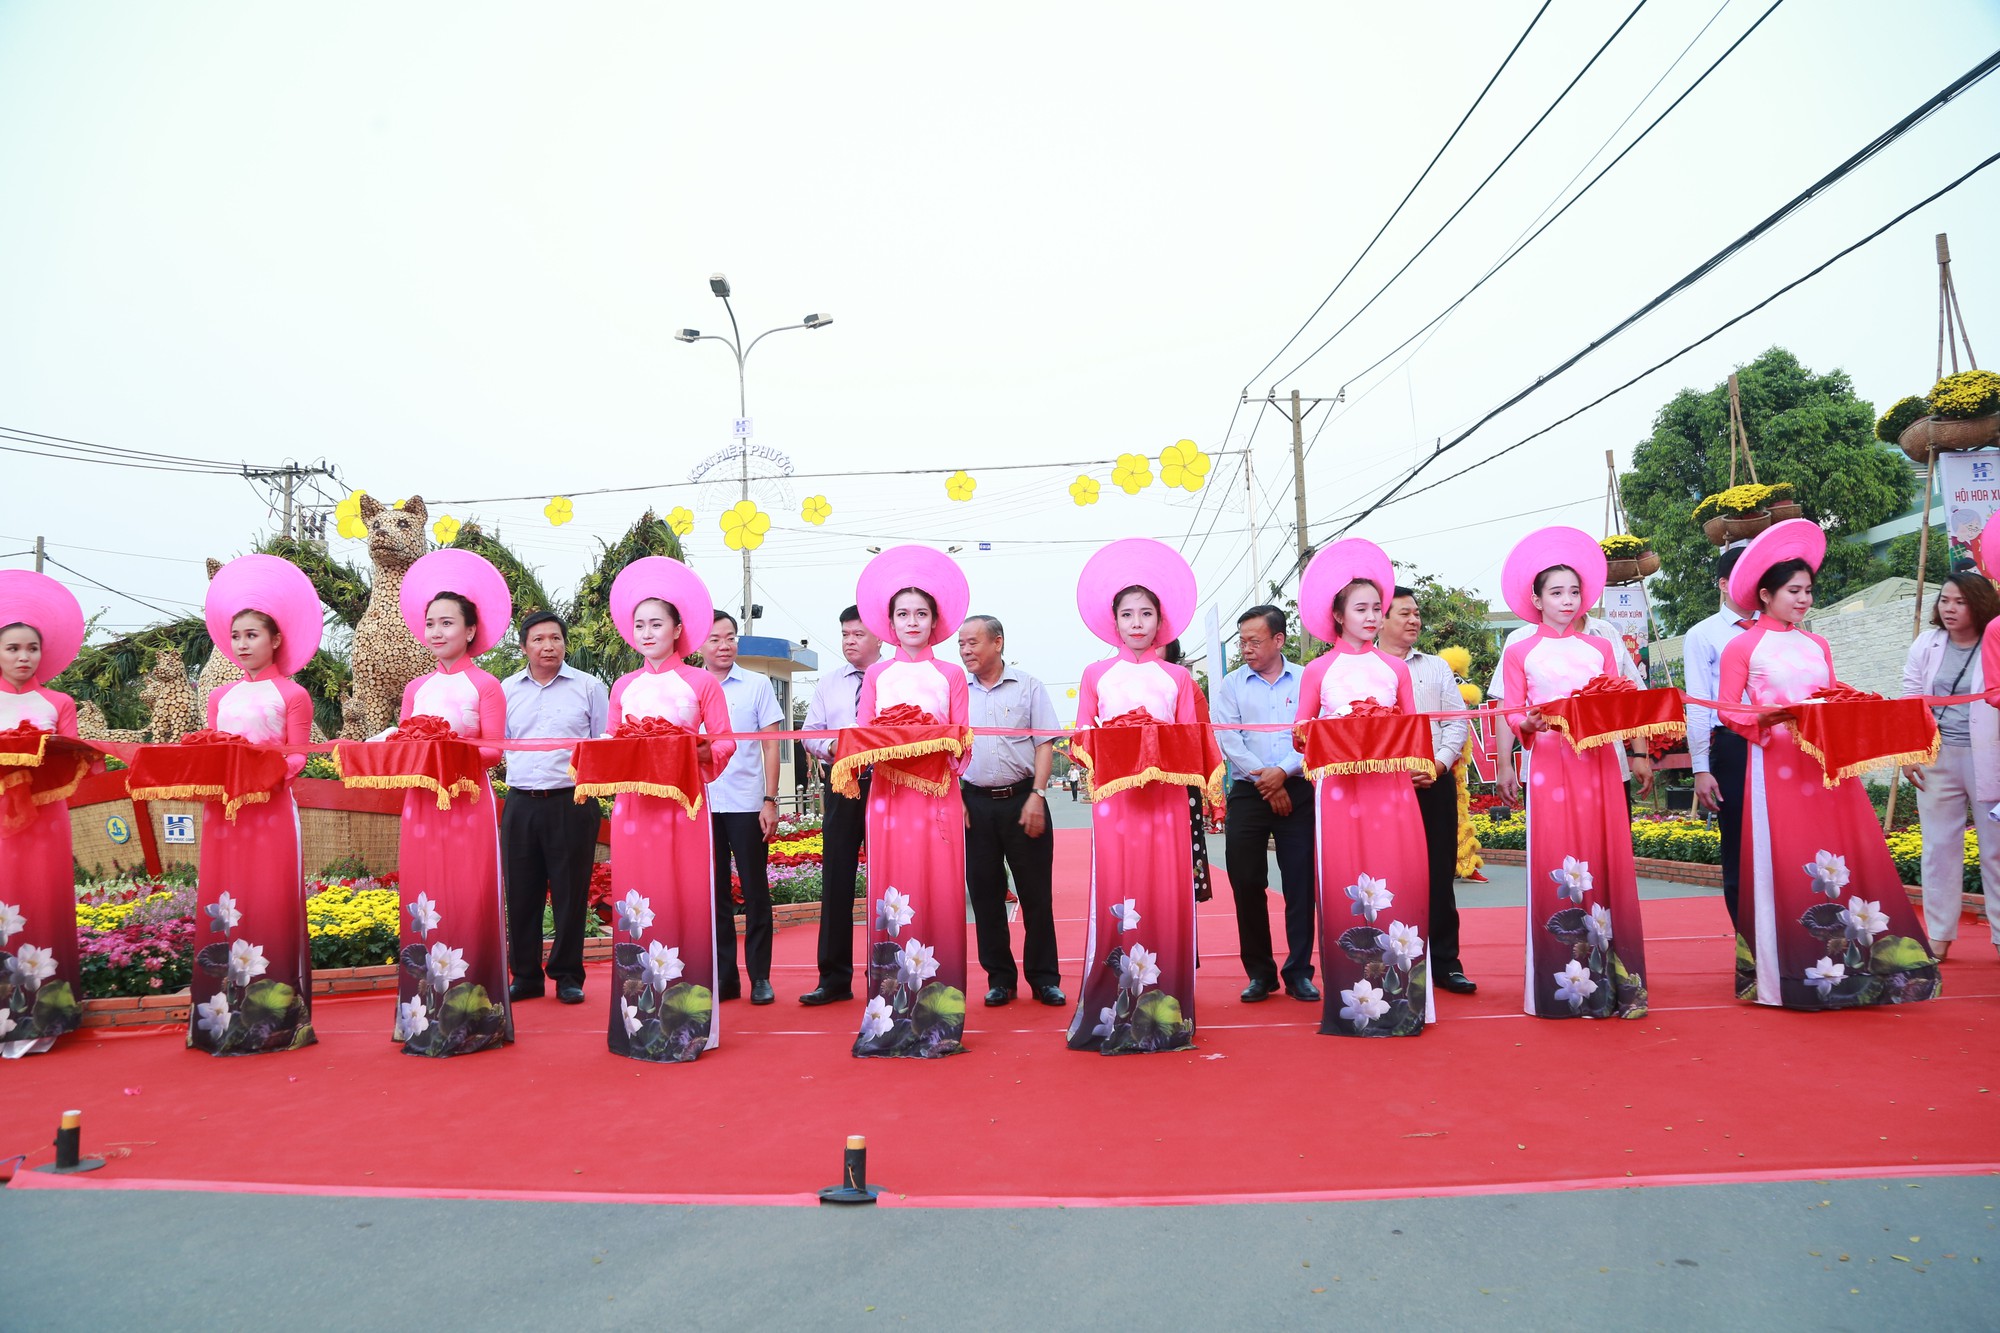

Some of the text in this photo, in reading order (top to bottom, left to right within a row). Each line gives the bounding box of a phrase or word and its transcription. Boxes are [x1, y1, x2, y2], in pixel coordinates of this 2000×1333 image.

[750, 444, 795, 476] PHƯỚC
[1955, 487, 1969, 503] HỘI
[1971, 489, 1989, 501] HOA
[1609, 609, 1617, 619] HỘI
[1629, 609, 1643, 618] XUÂN
